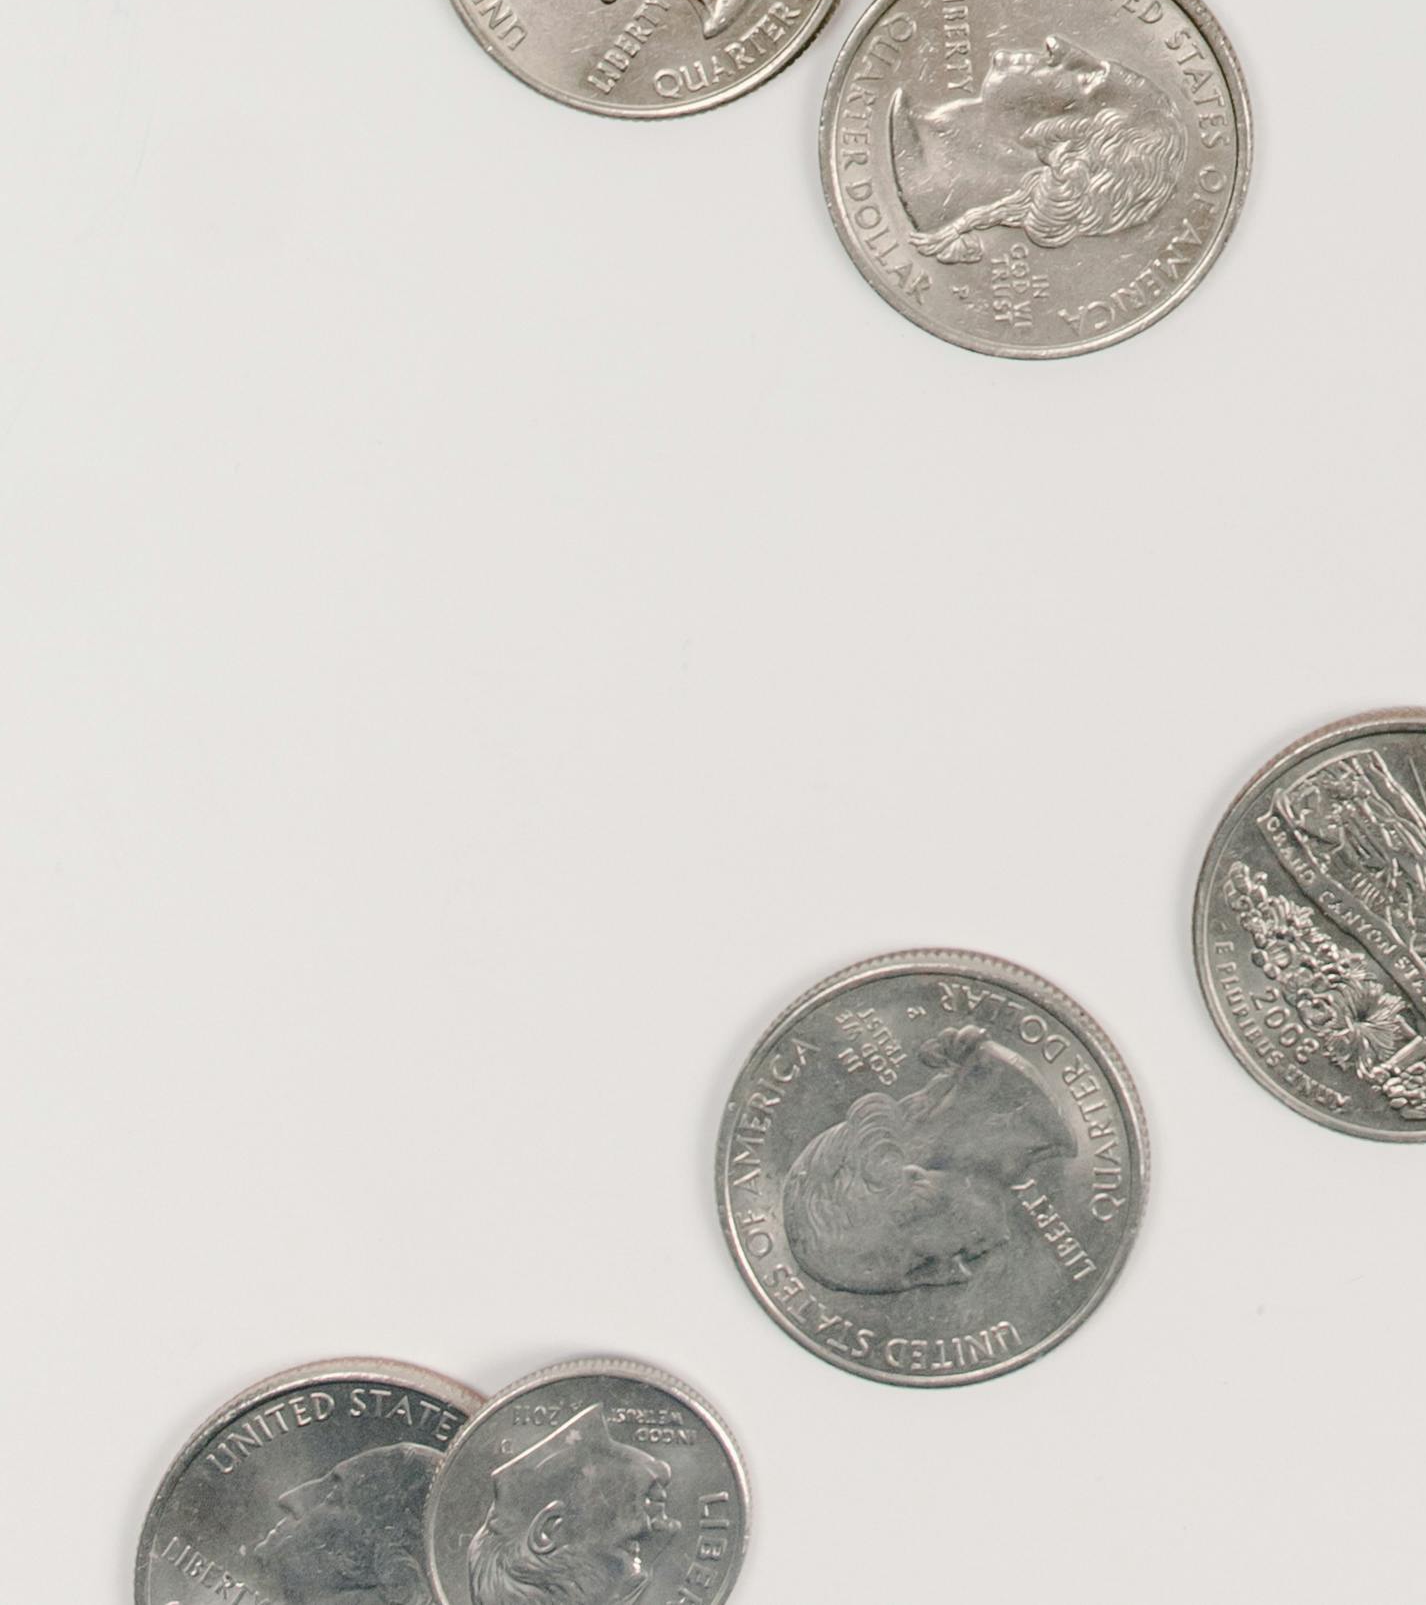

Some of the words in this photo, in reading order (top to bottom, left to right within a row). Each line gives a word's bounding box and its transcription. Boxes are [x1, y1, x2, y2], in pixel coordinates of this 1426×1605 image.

[652, 3, 802, 101] QUARTER
[841, 11, 918, 169] QUARTER
[1164, 28, 1230, 150] STATES
[1191, 165, 1230, 216] OF
[851, 175, 934, 306] DOLLAR
[1058, 217, 1202, 336] AMERICA
[1317, 890, 1397, 957] CANYON
[938, 981, 1071, 1065] DOLLAR
[1250, 987, 1320, 1066] 2008
[732, 1036, 820, 1197] AMERICA
[1061, 1053, 1125, 1223] QUARTER
[741, 1207, 774, 1259] OF
[1010, 1177, 1097, 1282] LIBERTY
[764, 1263, 874, 1358] STATES
[886, 1320, 1024, 1371] UNITED
[205, 1391, 336, 1474] UNITED
[349, 1388, 459, 1442] STATE
